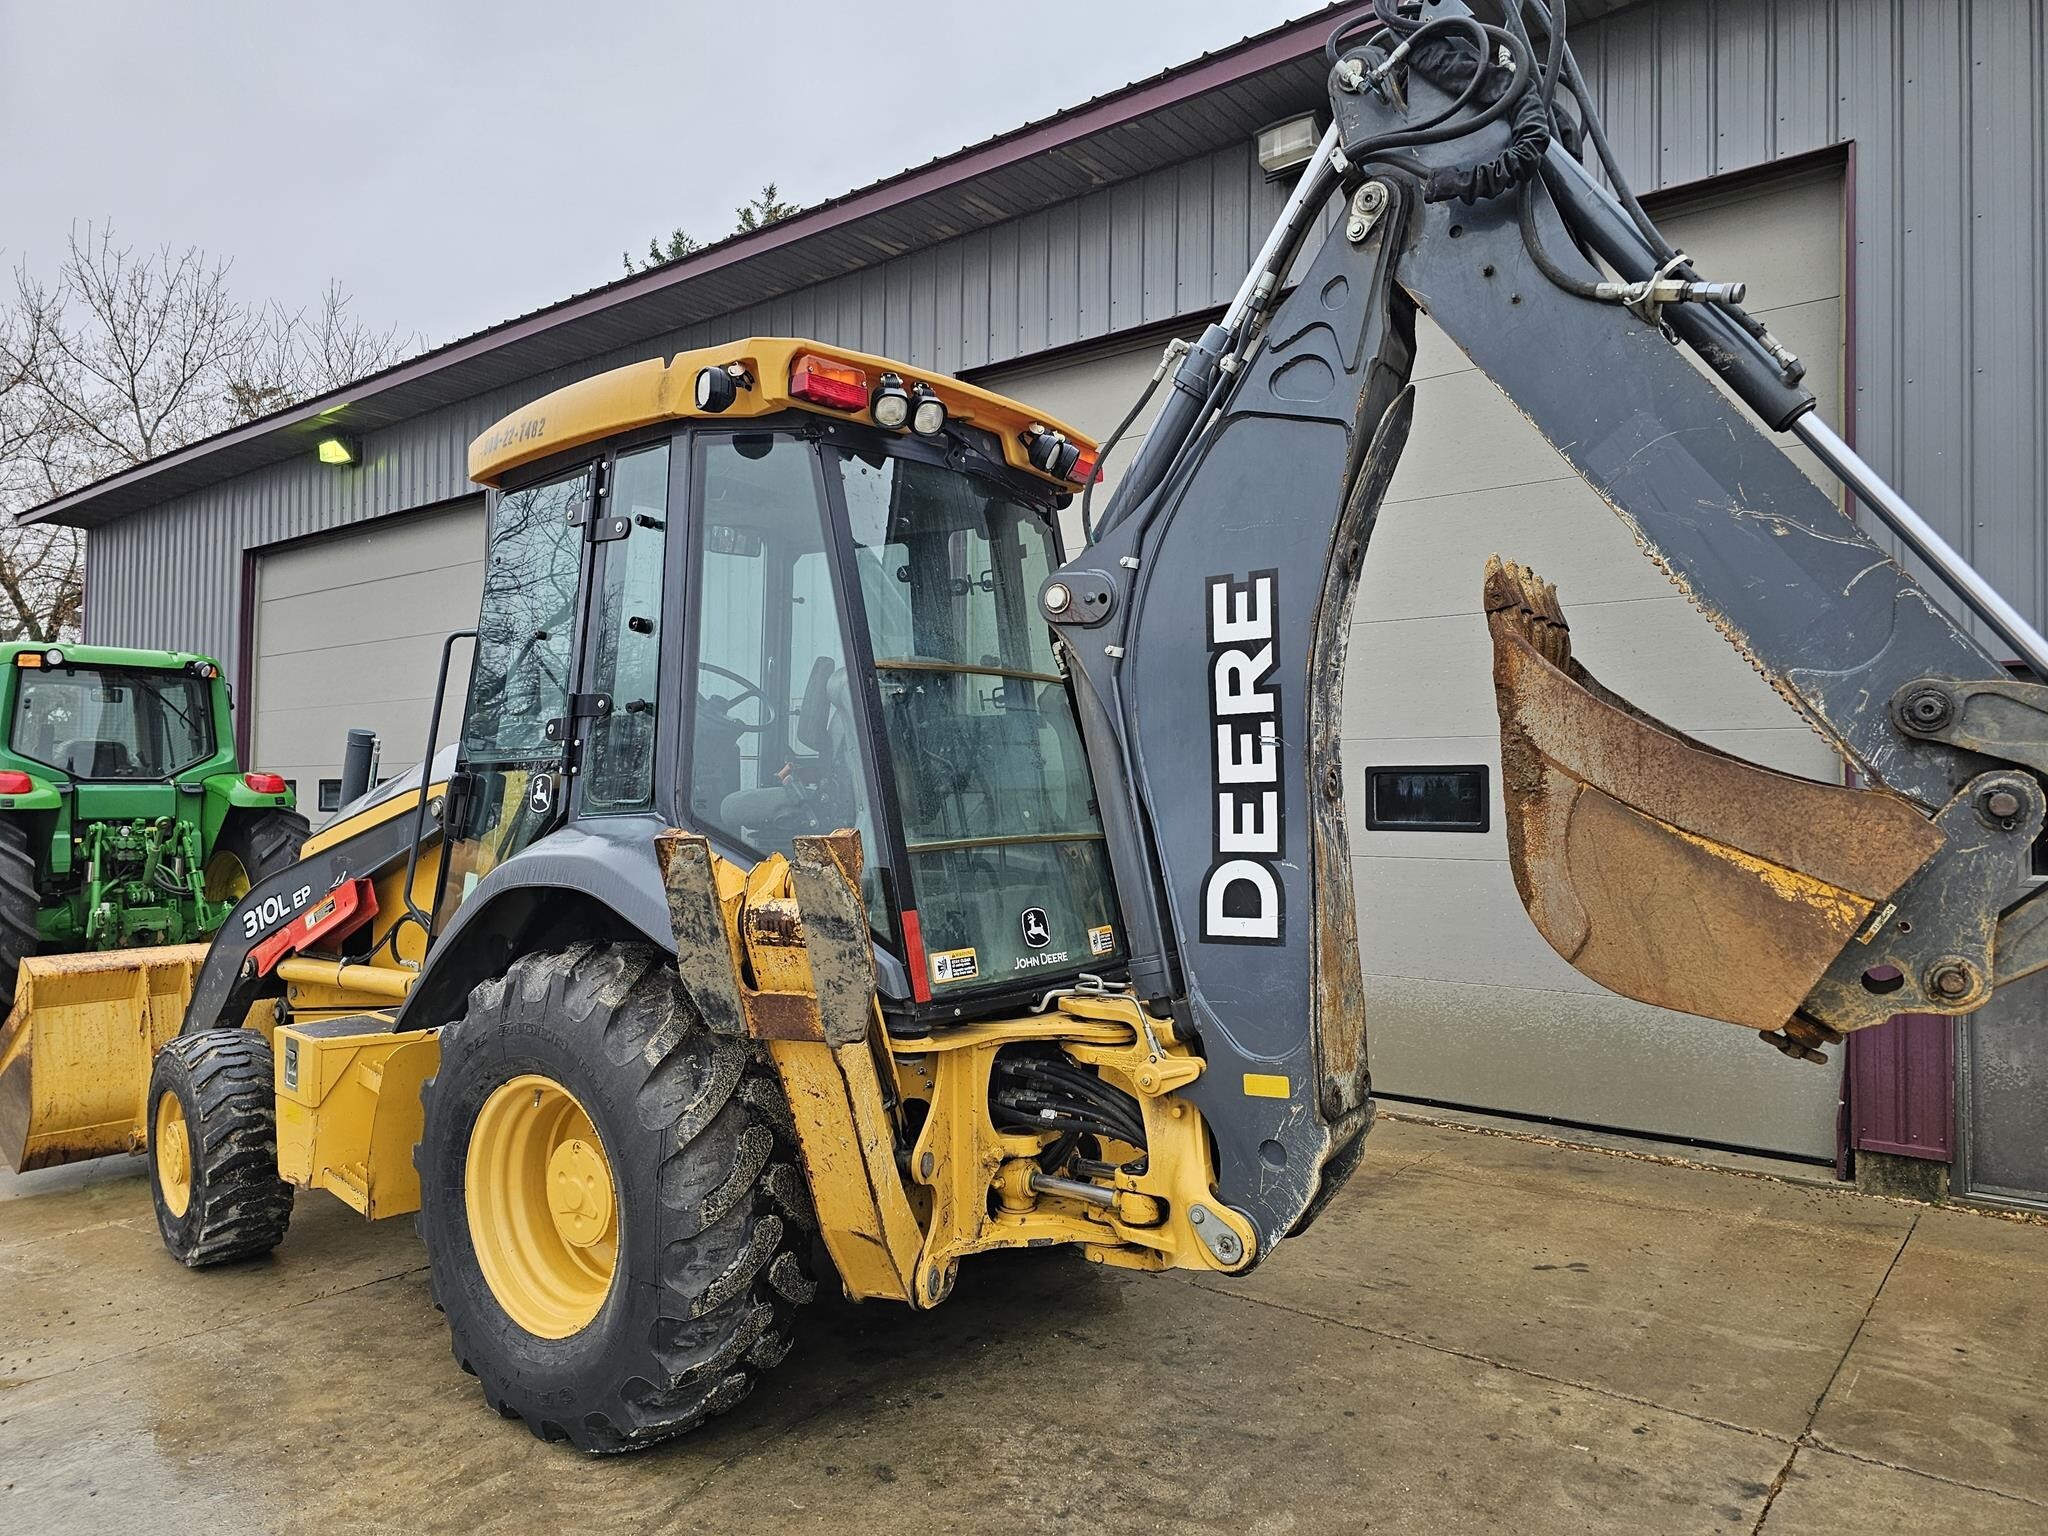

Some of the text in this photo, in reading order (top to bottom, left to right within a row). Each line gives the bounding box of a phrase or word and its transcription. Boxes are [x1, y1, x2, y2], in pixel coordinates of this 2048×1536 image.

[1205, 576, 1279, 939] DEERE
[243, 894, 291, 939] 310L
[293, 885, 311, 909] EP
[1014, 951, 1069, 970] JOHN DEERE
